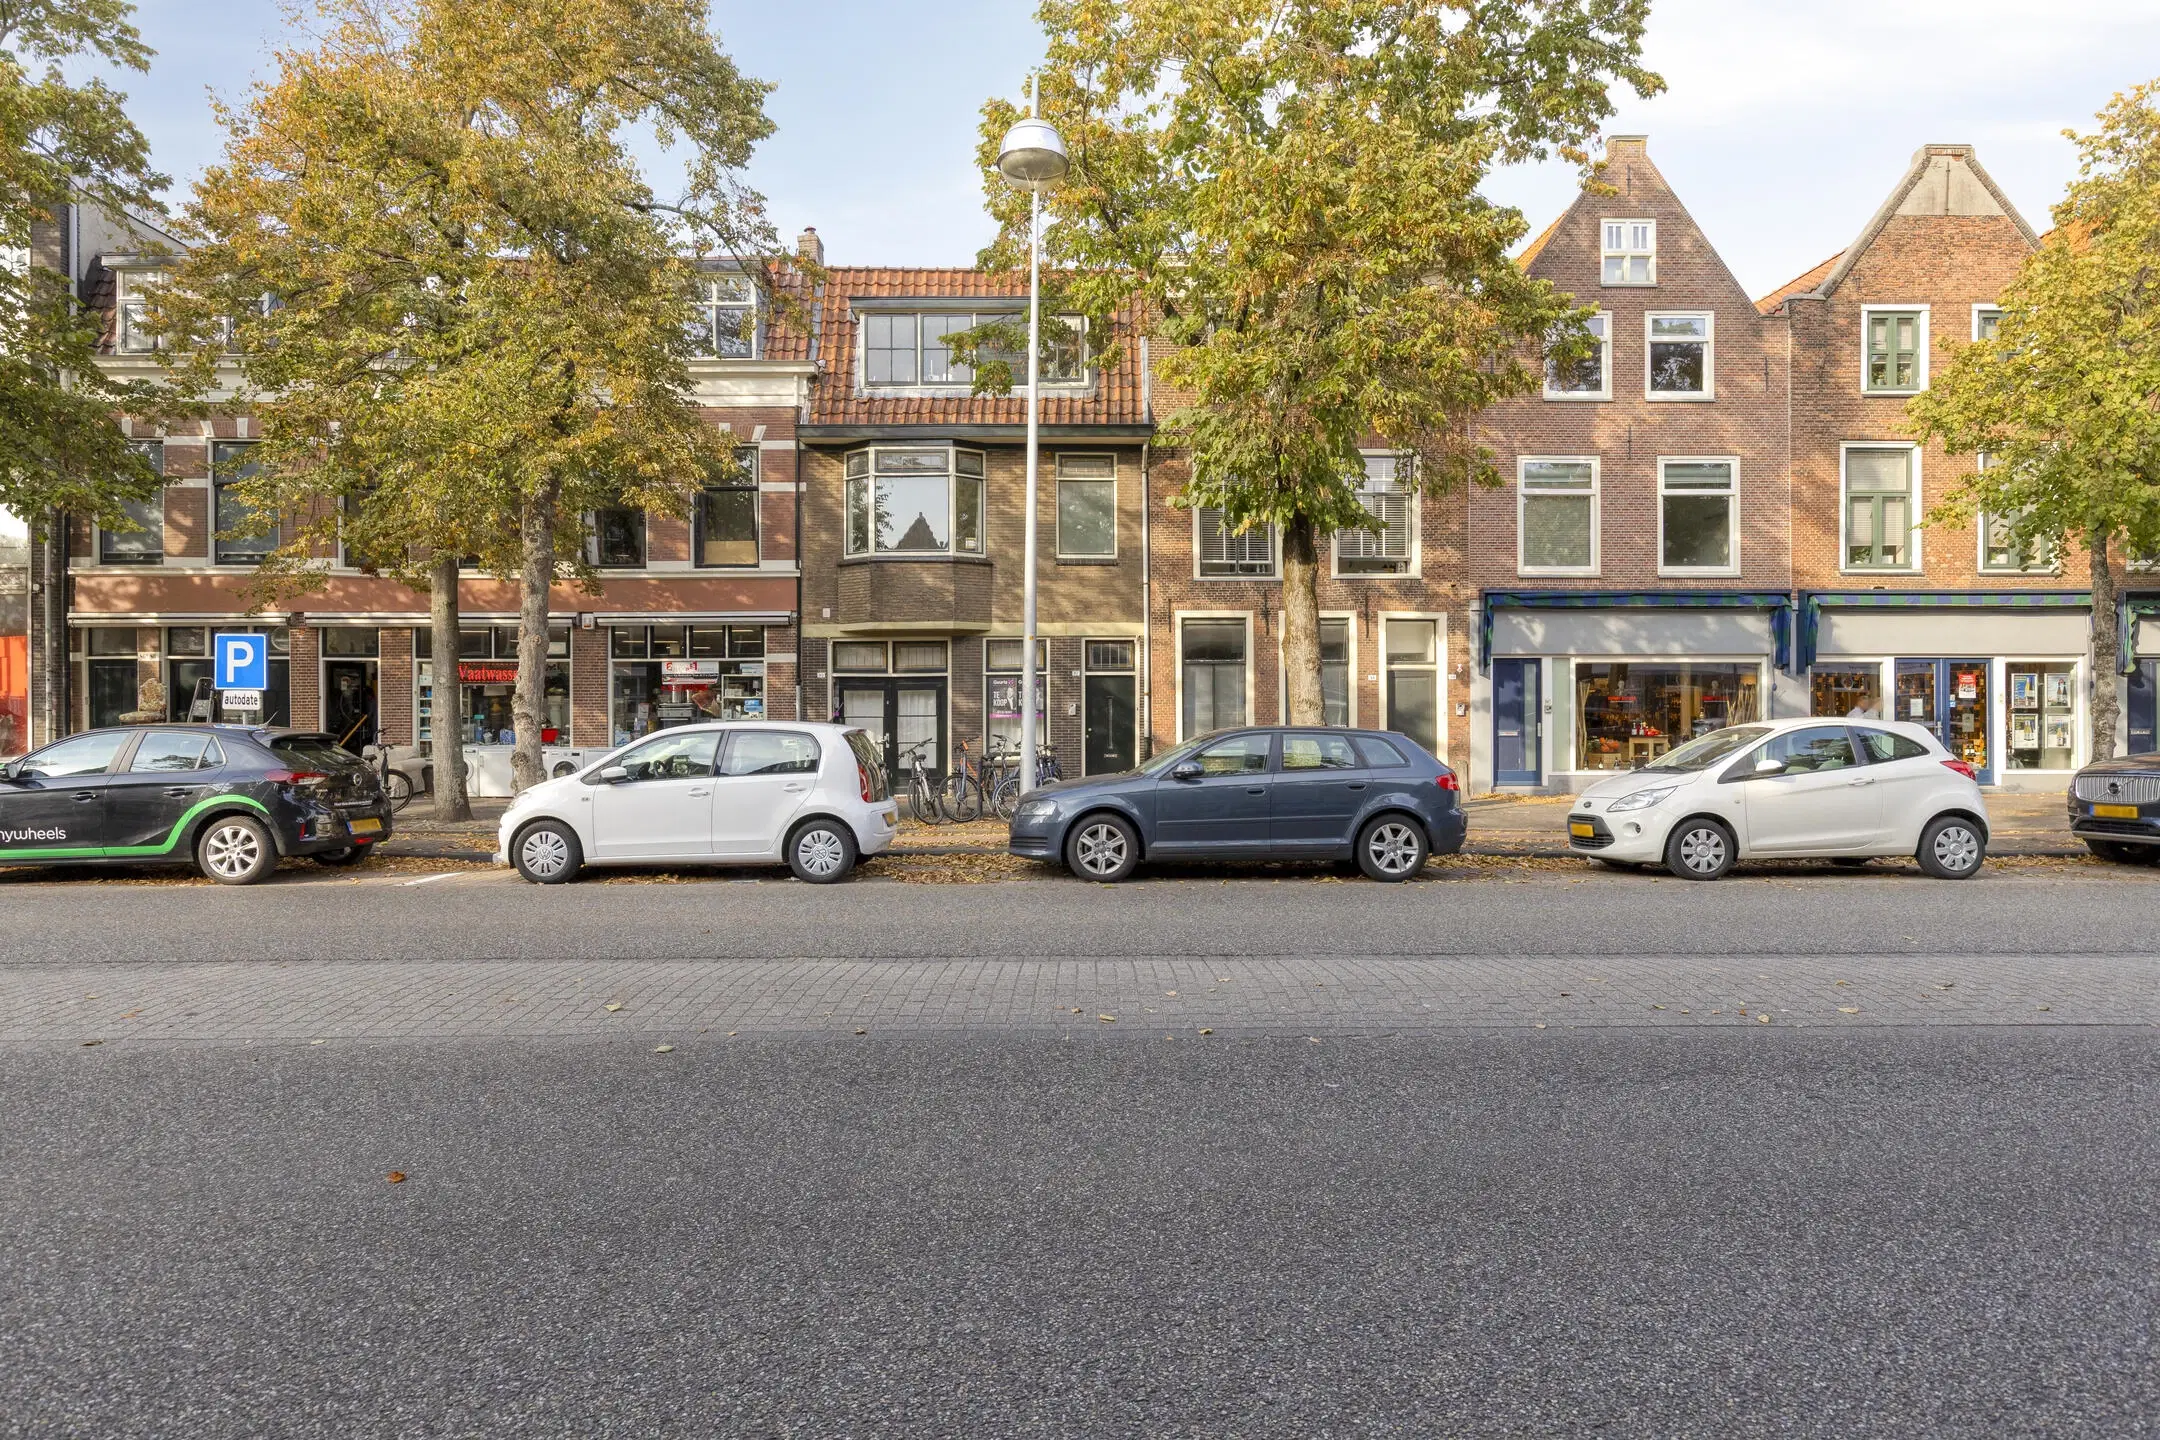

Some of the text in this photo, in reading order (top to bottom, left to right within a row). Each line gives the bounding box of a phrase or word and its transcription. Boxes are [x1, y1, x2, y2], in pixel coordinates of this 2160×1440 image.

[226, 641, 254, 683] P
[224, 693, 259, 706] autodate
[993, 691, 1000, 699] TE
